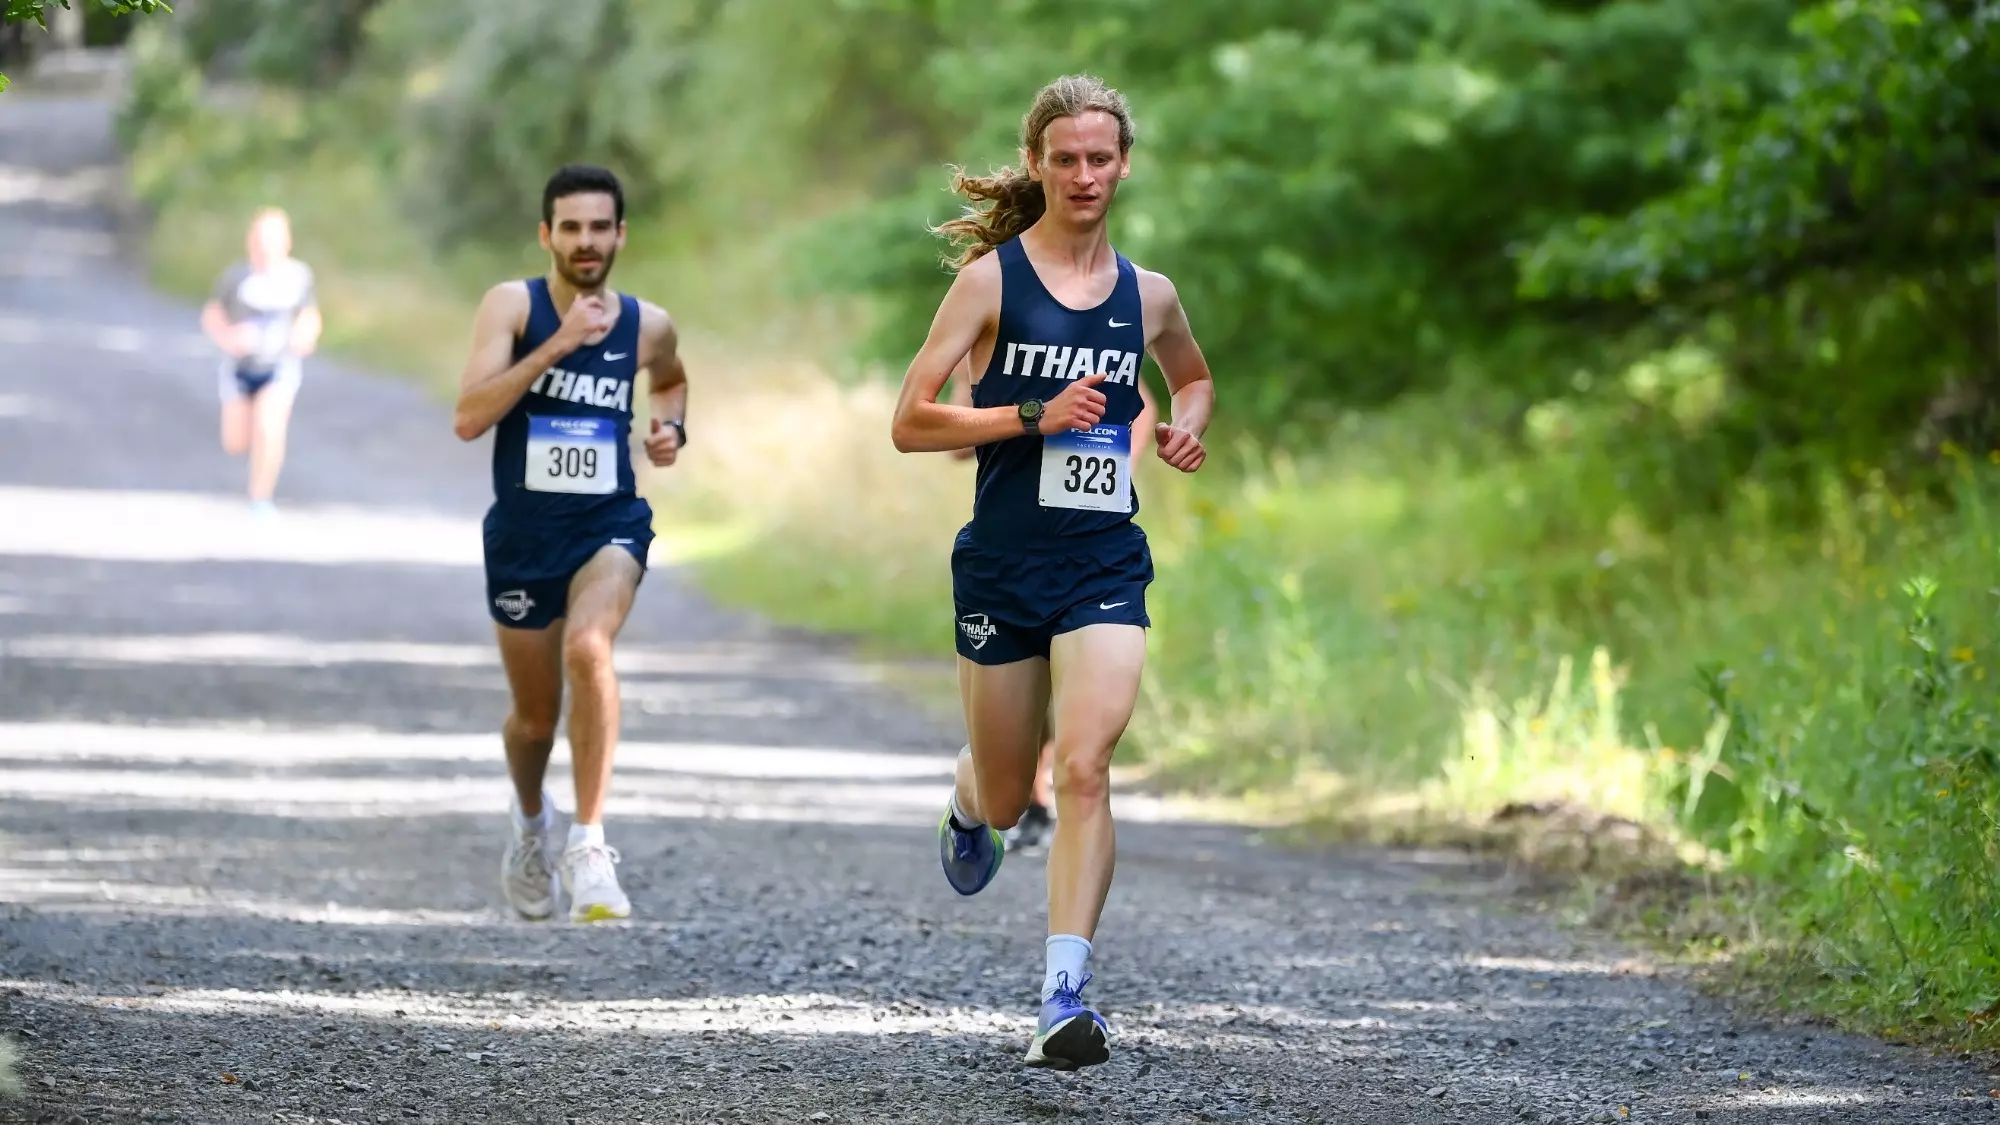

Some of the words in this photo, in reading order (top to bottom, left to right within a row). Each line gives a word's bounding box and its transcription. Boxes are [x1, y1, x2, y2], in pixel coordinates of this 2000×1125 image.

[1003, 342, 1138, 386] ITHACA
[530, 367, 630, 412] THACA
[1070, 427, 1118, 436] FLCON
[548, 446, 597, 478] 309
[1064, 455, 1117, 496] 323
[959, 621, 997, 636] ITHACA
